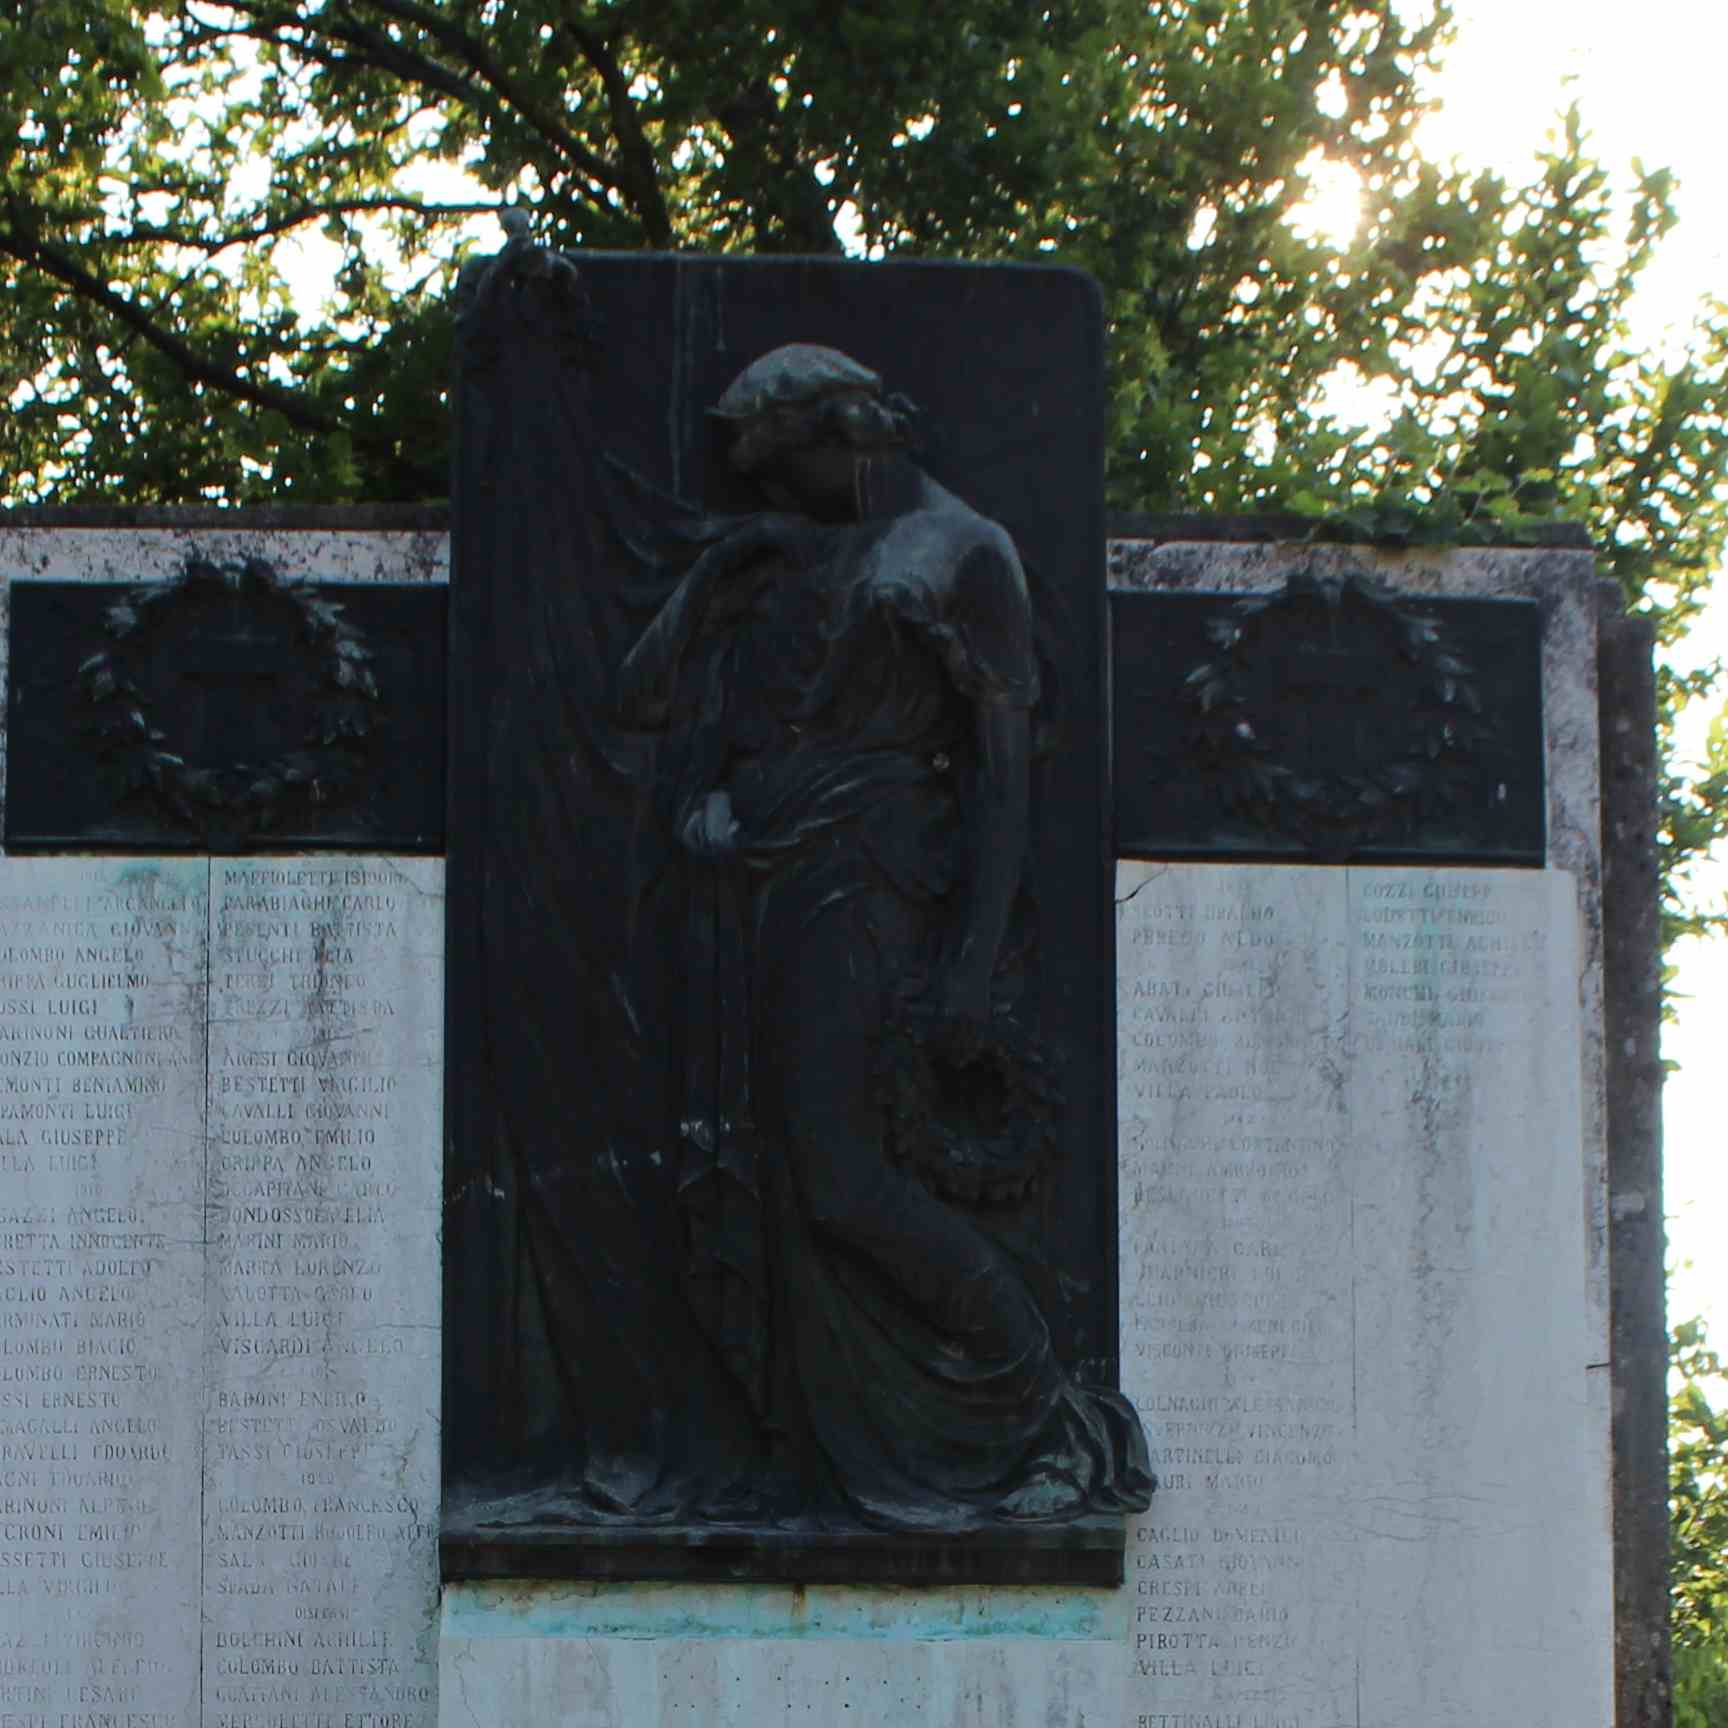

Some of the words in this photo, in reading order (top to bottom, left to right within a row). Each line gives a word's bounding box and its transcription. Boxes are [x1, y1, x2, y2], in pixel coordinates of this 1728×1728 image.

[75, 947, 145, 963] ANGELO
[54, 974, 150, 990] GUGLIELMO
[48, 1000, 98, 1015] LUIGI
[222, 1077, 305, 1093] BESTETTI
[40, 1129, 130, 1145] GIUSEPPE
[41, 1392, 122, 1408] ERNESTO
[311, 1658, 400, 1676] BATTISTA
